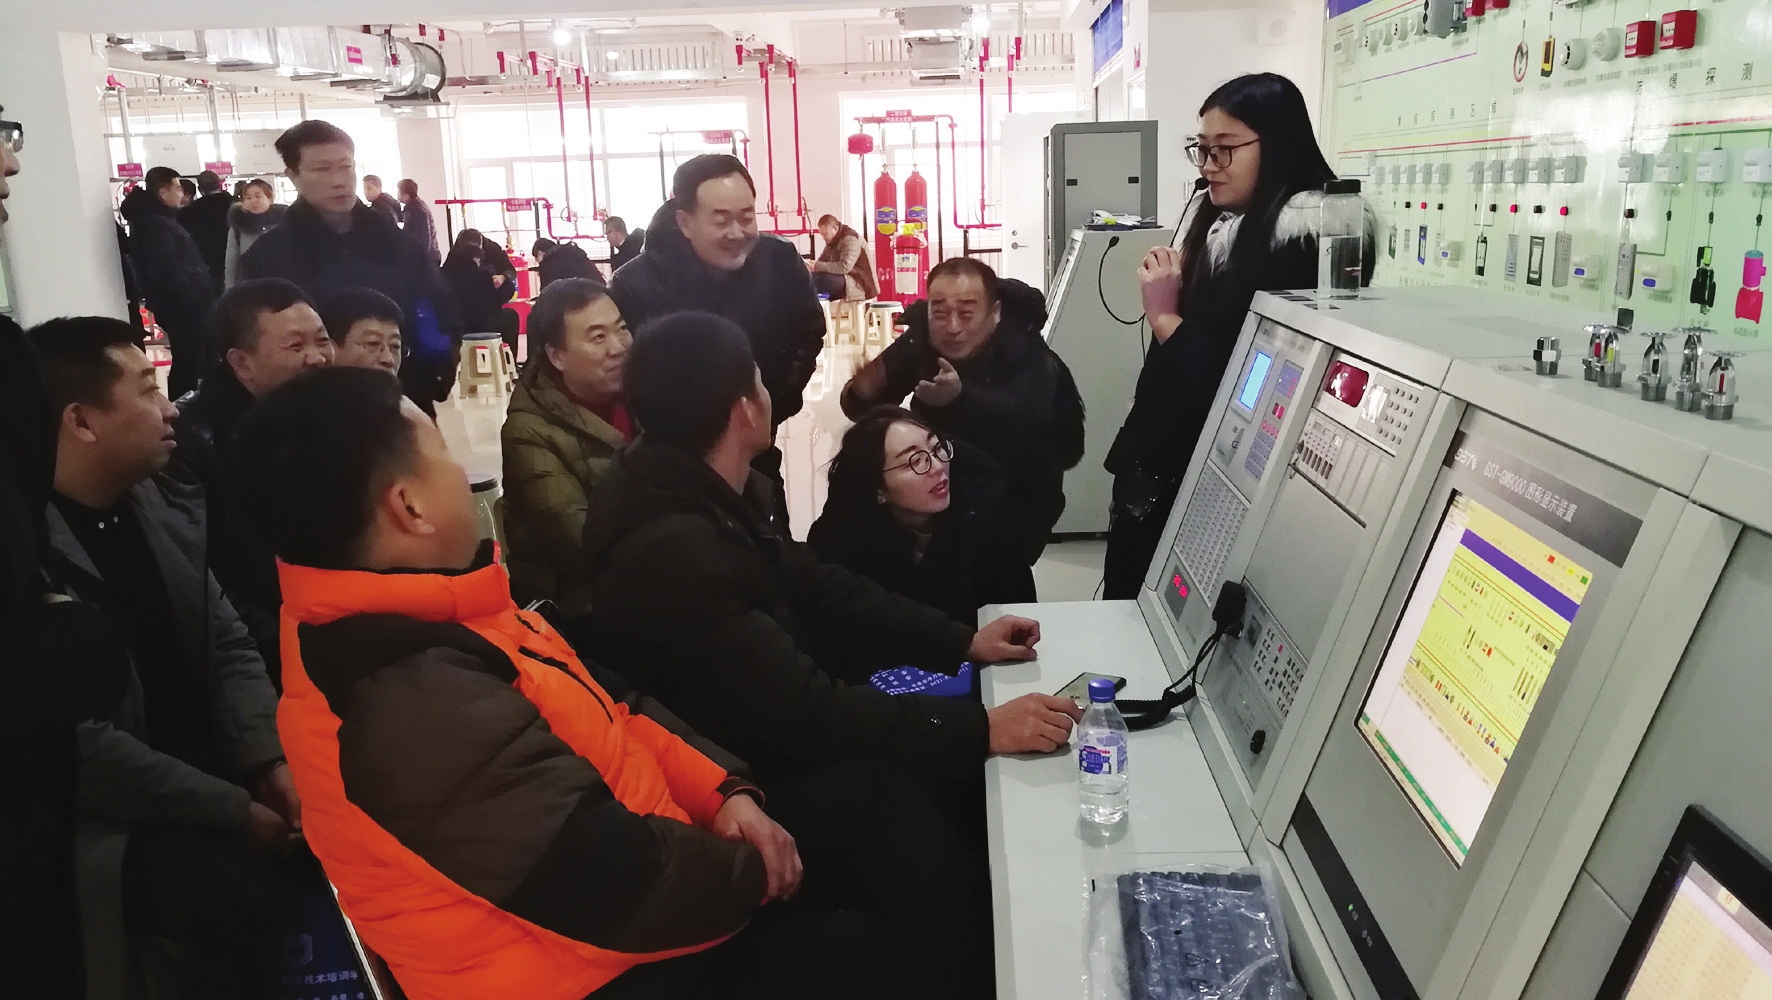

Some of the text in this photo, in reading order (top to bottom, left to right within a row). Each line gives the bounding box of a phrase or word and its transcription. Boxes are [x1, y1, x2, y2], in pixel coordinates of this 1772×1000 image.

[1483, 461, 1527, 496] GST-GM9000
[1524, 480, 1578, 523] 图形显示装置
